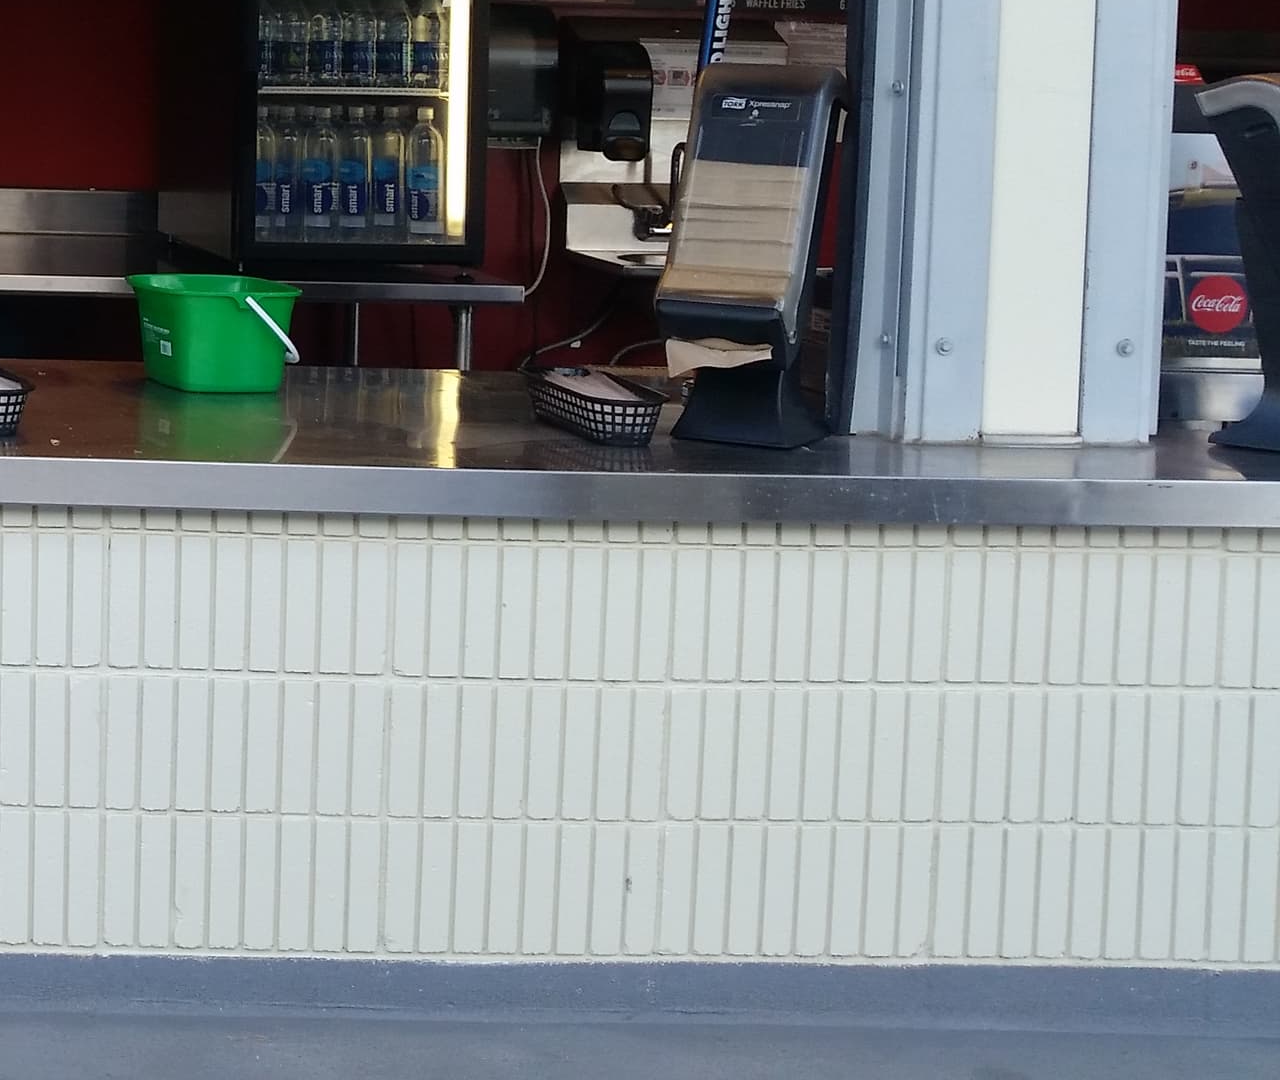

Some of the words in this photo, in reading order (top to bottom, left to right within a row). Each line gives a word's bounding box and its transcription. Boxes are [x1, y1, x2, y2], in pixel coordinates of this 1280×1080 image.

[280, 183, 291, 214] smart
[313, 182, 323, 214] smart
[348, 184, 358, 214] smart
[385, 183, 395, 213] smart
[410, 190, 419, 220] smart
[1191, 295, 1243, 313] Coca-Cola
